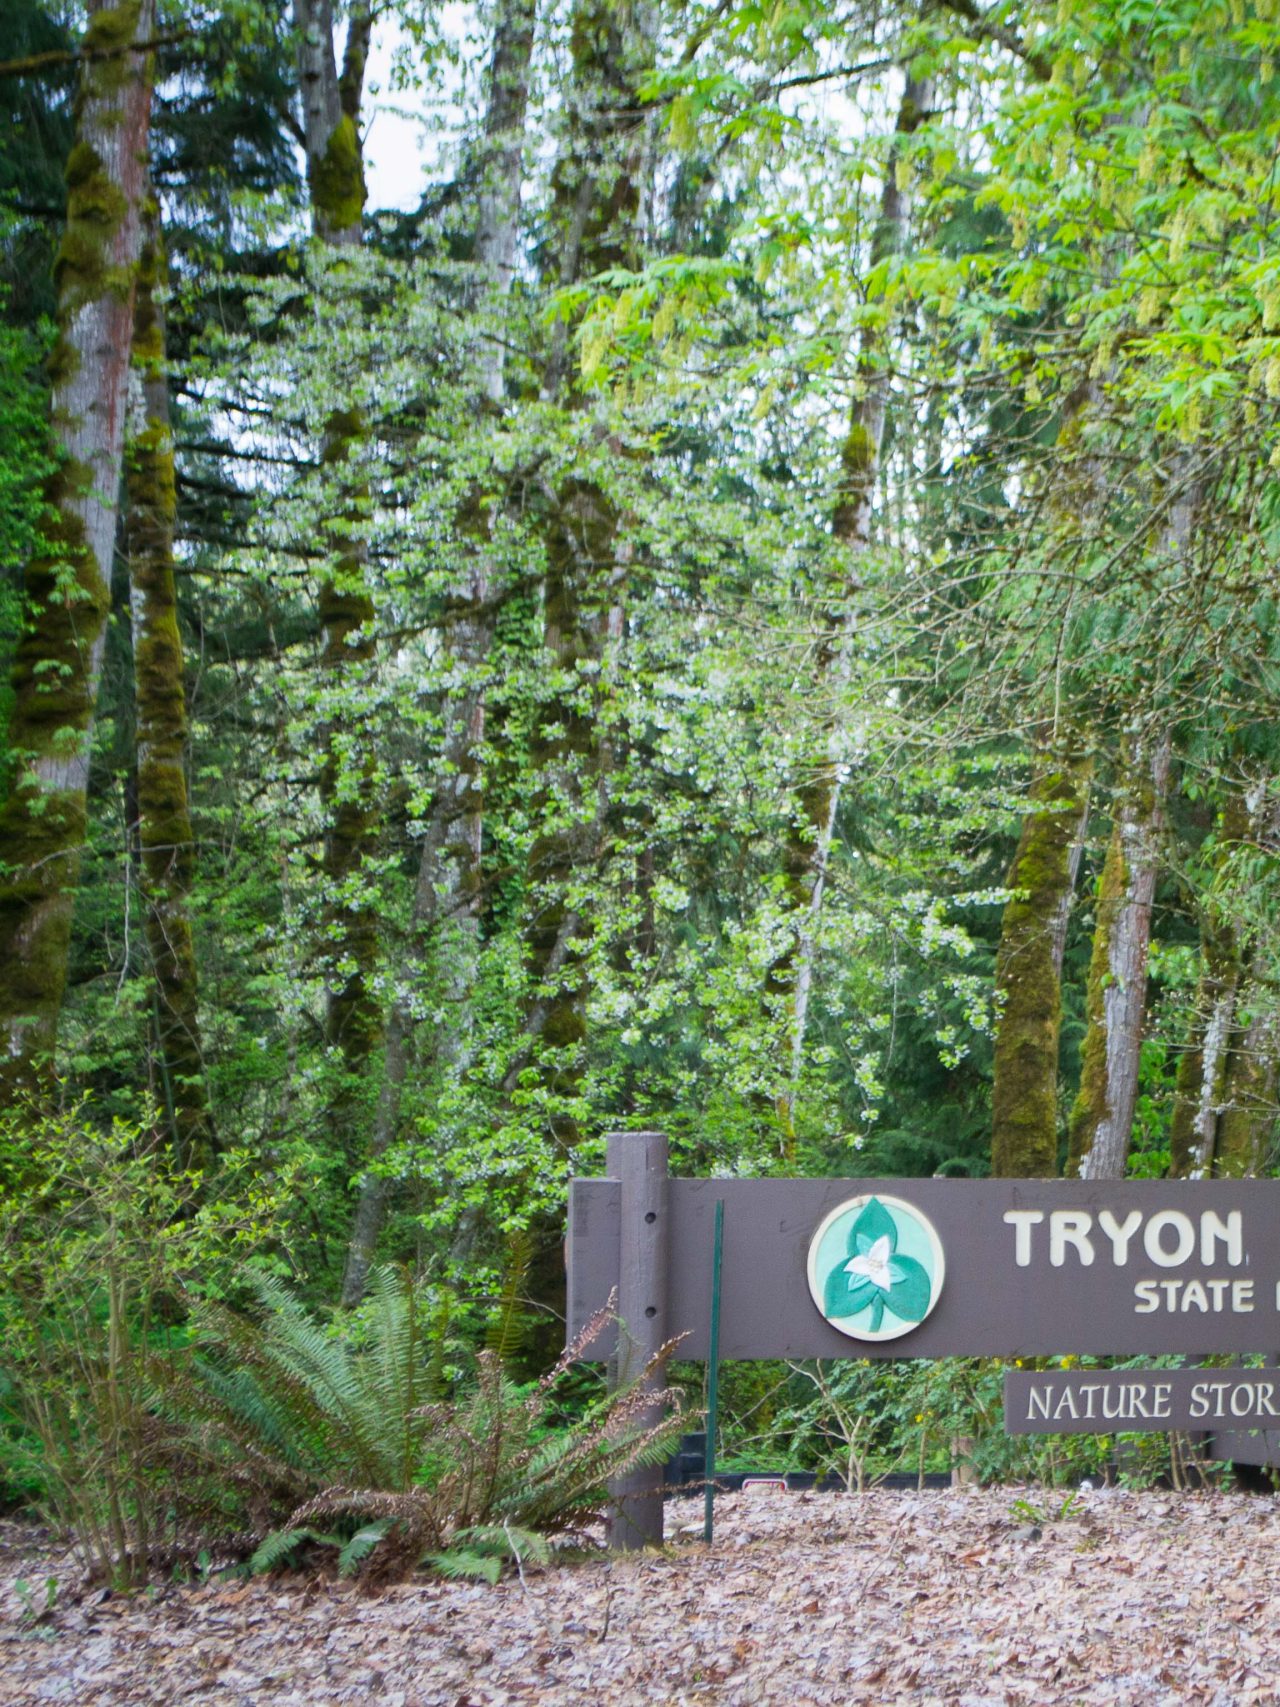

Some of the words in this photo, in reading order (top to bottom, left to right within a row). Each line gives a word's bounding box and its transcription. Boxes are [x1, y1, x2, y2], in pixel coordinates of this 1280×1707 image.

[1003, 1210, 1244, 1268] TRYON
[1133, 1278, 1255, 1314] STATE
[1025, 1384, 1172, 1420] NATURE
